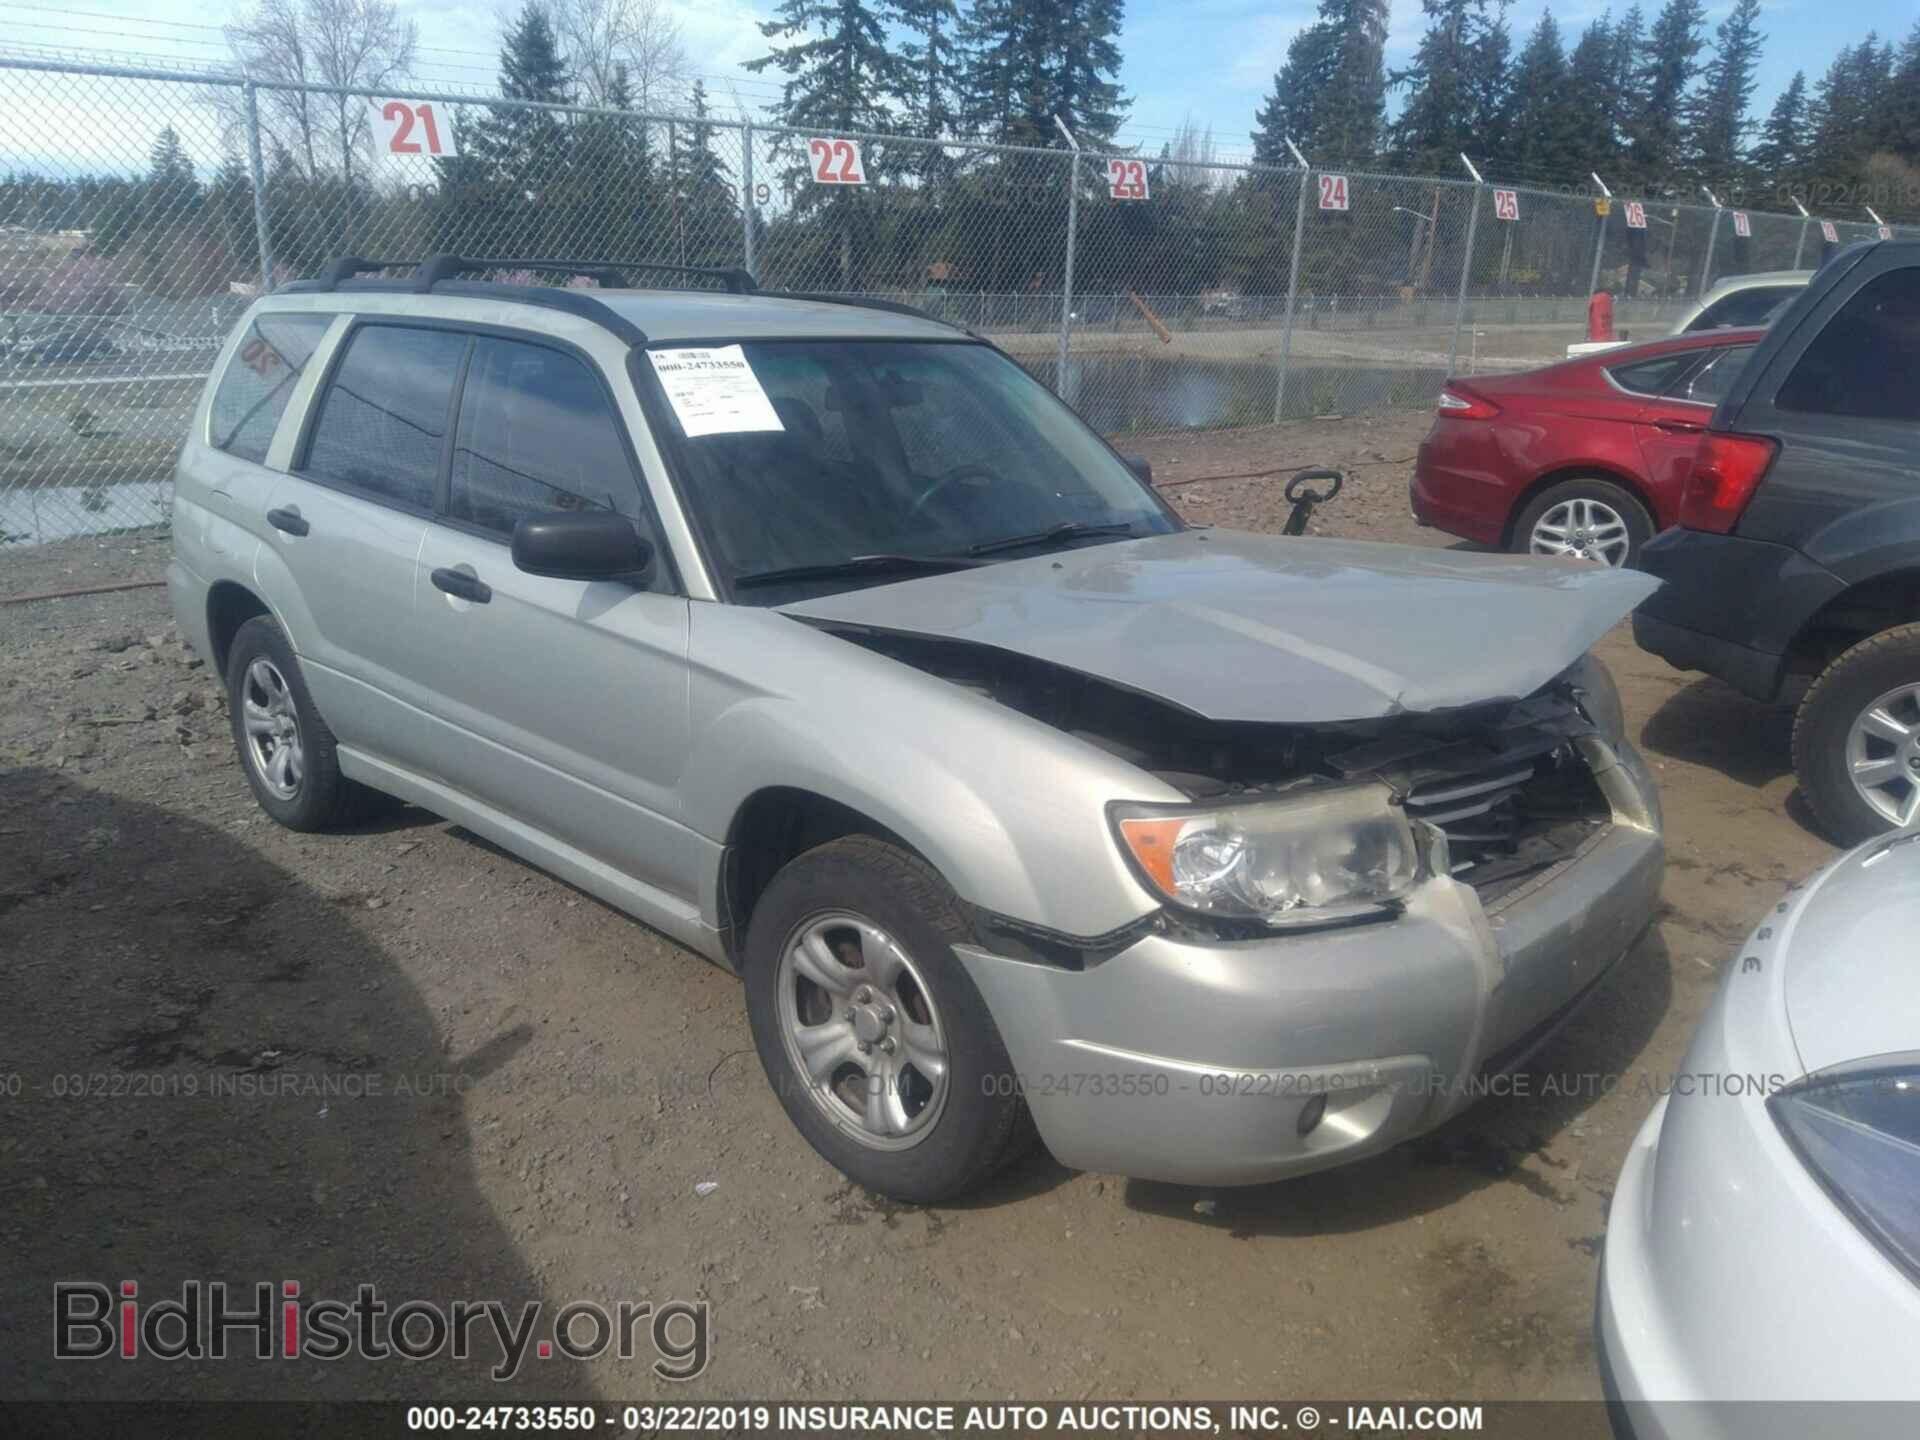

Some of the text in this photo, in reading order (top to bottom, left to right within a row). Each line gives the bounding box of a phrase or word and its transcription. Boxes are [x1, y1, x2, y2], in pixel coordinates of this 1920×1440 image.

[382, 101, 441, 154] 21
[809, 138, 862, 183] 22
[1109, 160, 1147, 198] 23
[1320, 177, 1348, 209] 24
[1496, 191, 1518, 219] 25
[1625, 202, 1645, 227] 26
